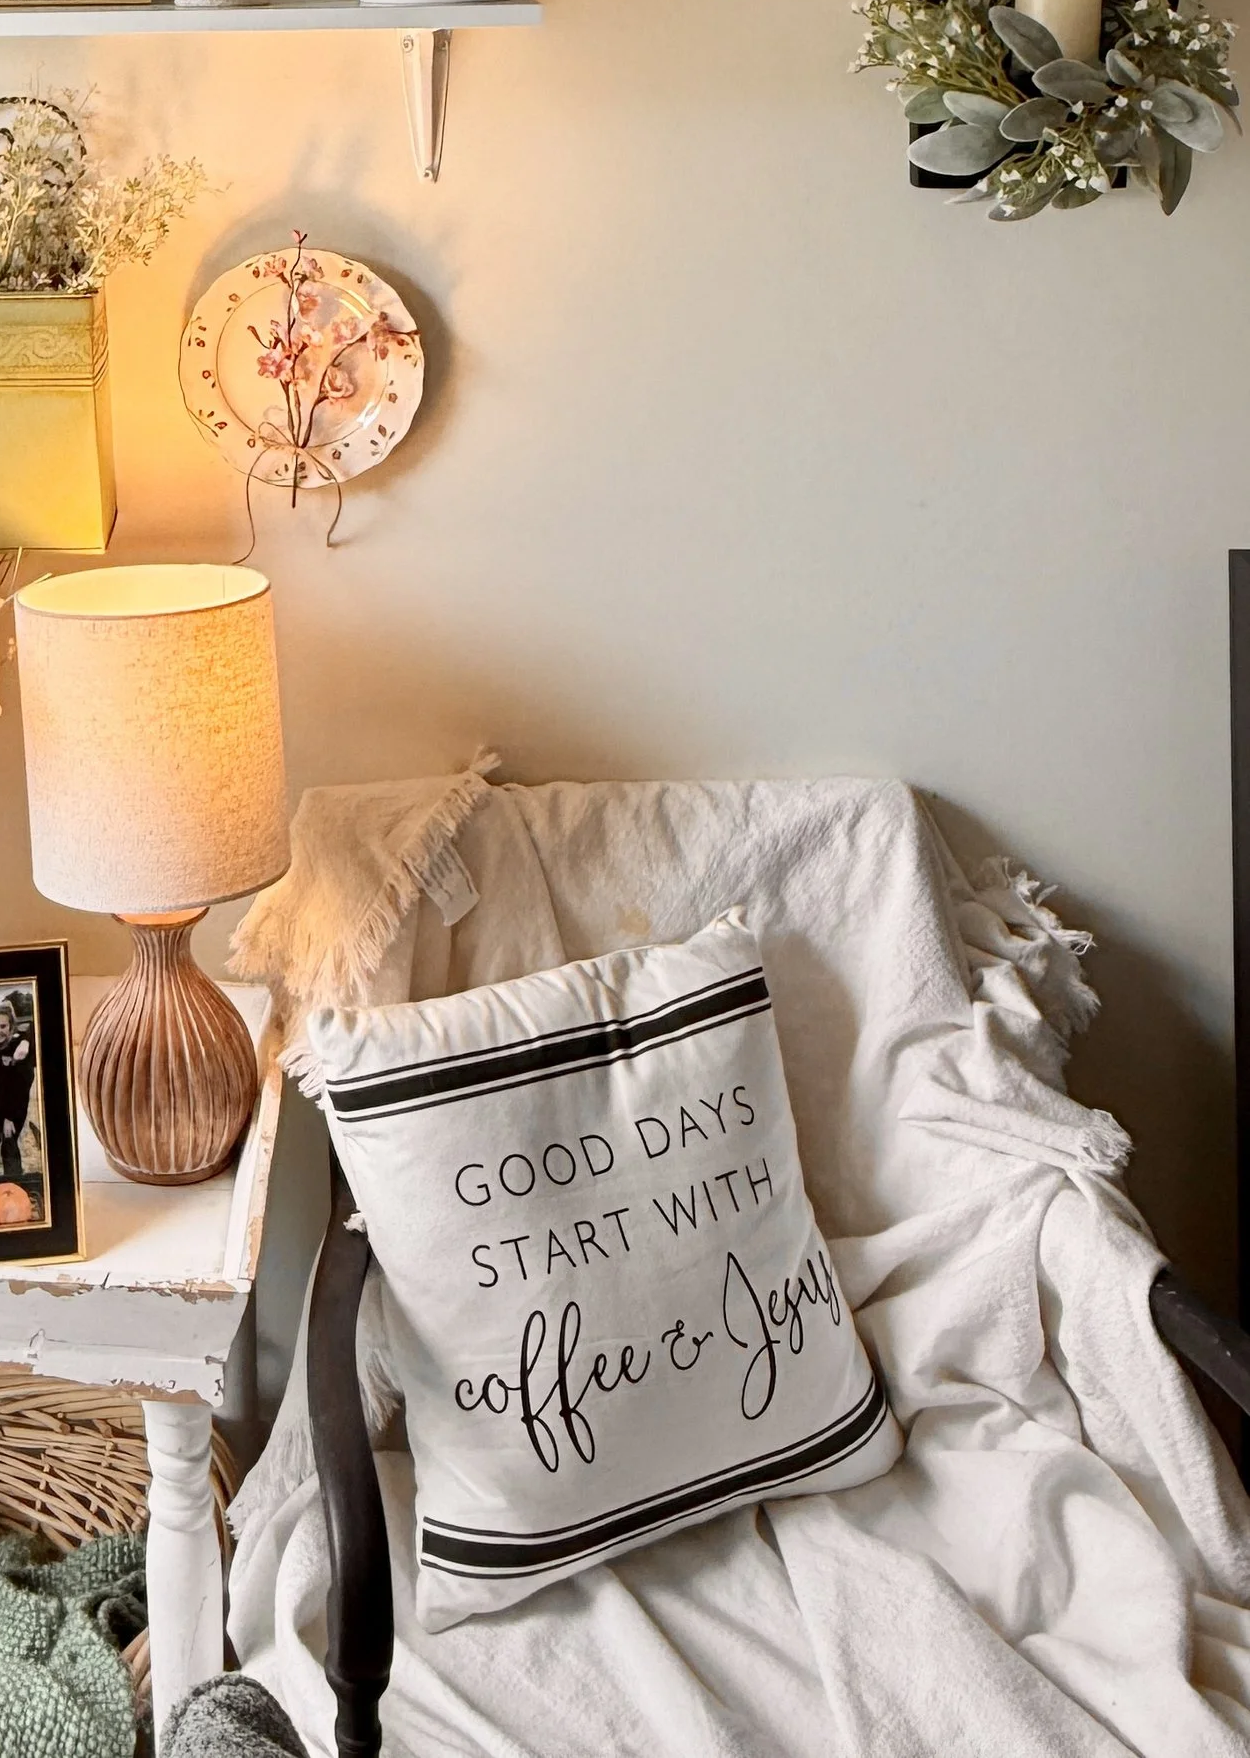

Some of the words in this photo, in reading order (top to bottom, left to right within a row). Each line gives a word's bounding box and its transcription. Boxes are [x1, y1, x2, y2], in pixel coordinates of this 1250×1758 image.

[454, 1134, 615, 1208] GOOD
[634, 1085, 756, 1160] DAYS
[471, 1207, 632, 1289] START
[652, 1157, 773, 1237] WITH
[454, 1300, 652, 1474] coffee
[660, 1319, 714, 1371] &
